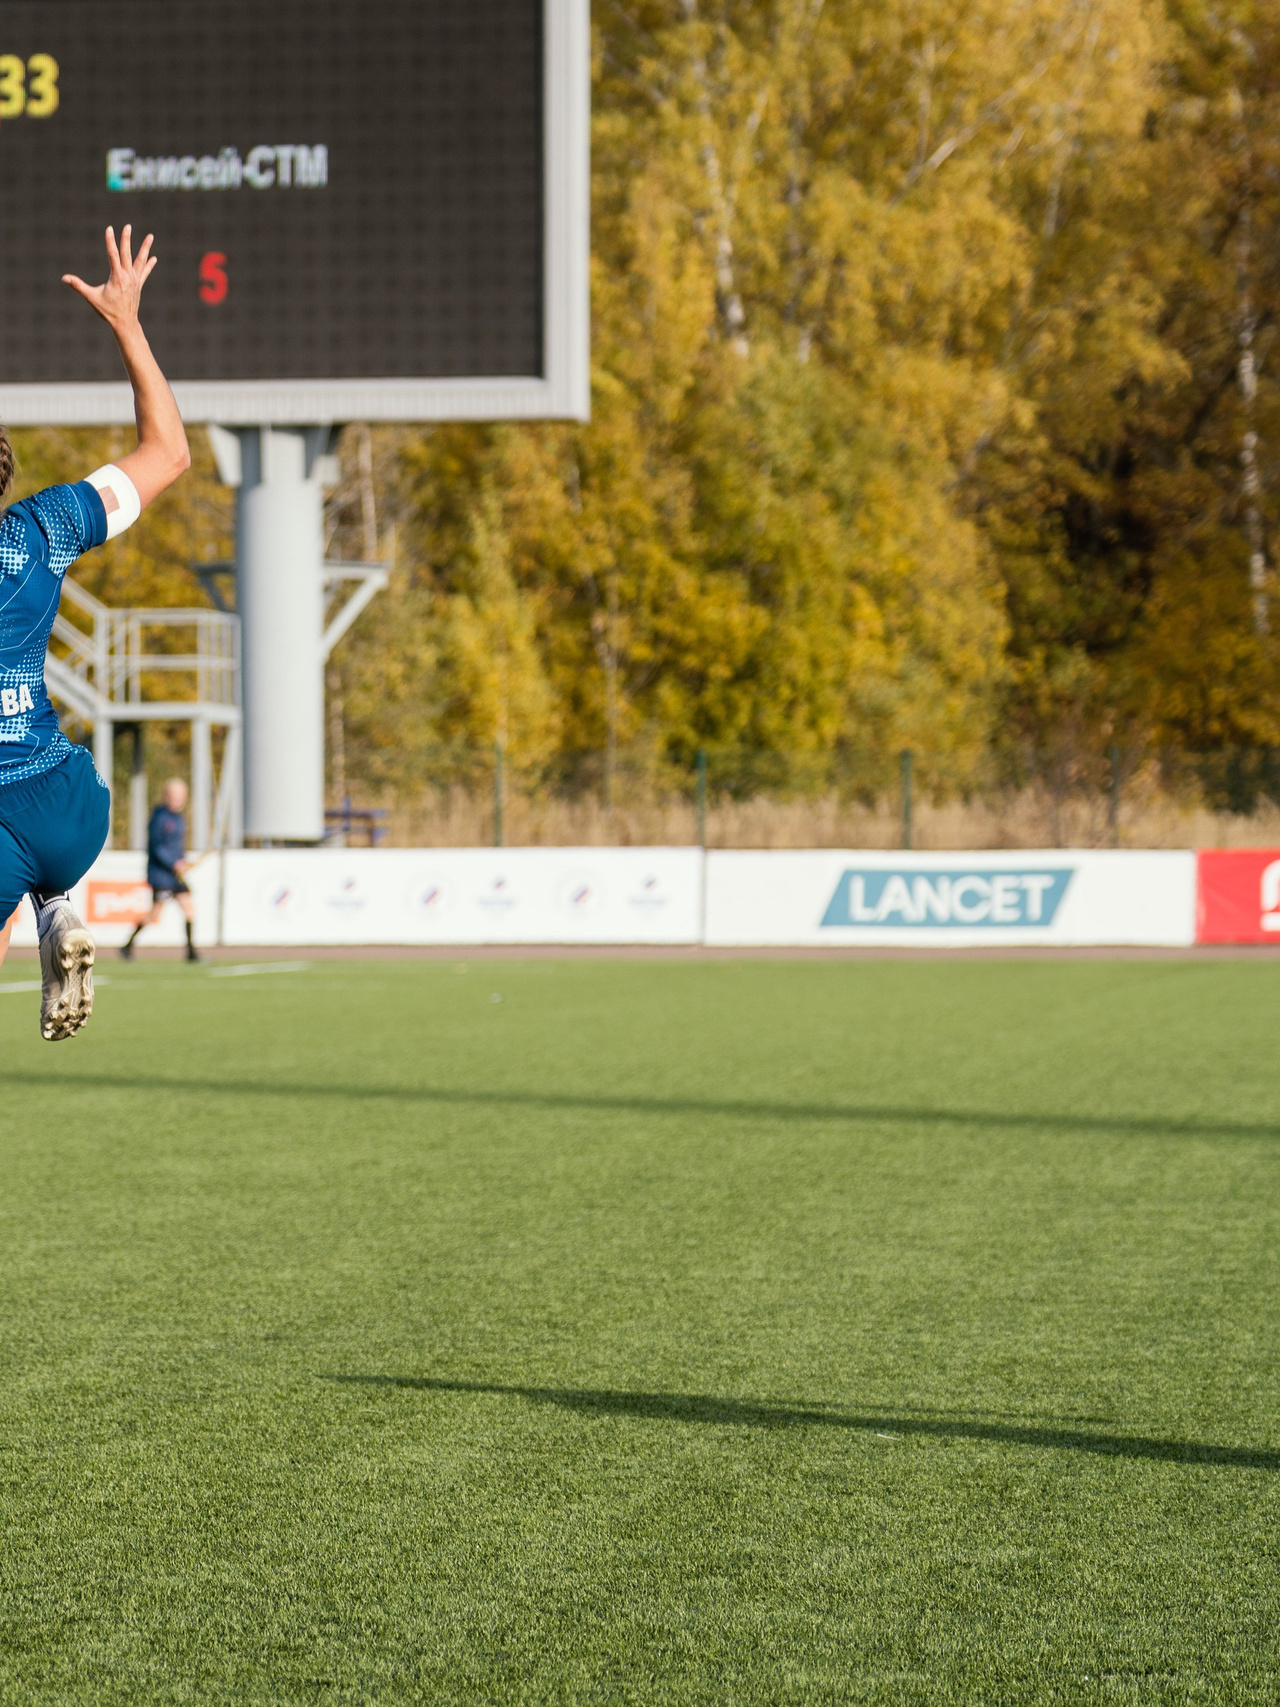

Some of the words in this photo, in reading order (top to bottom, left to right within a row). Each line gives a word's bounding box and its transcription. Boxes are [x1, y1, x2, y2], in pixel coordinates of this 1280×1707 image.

[106, 144, 329, 191] Енисей-СТМ
[198, 252, 229, 305] 5
[848, 874, 1056, 923] LANCET
